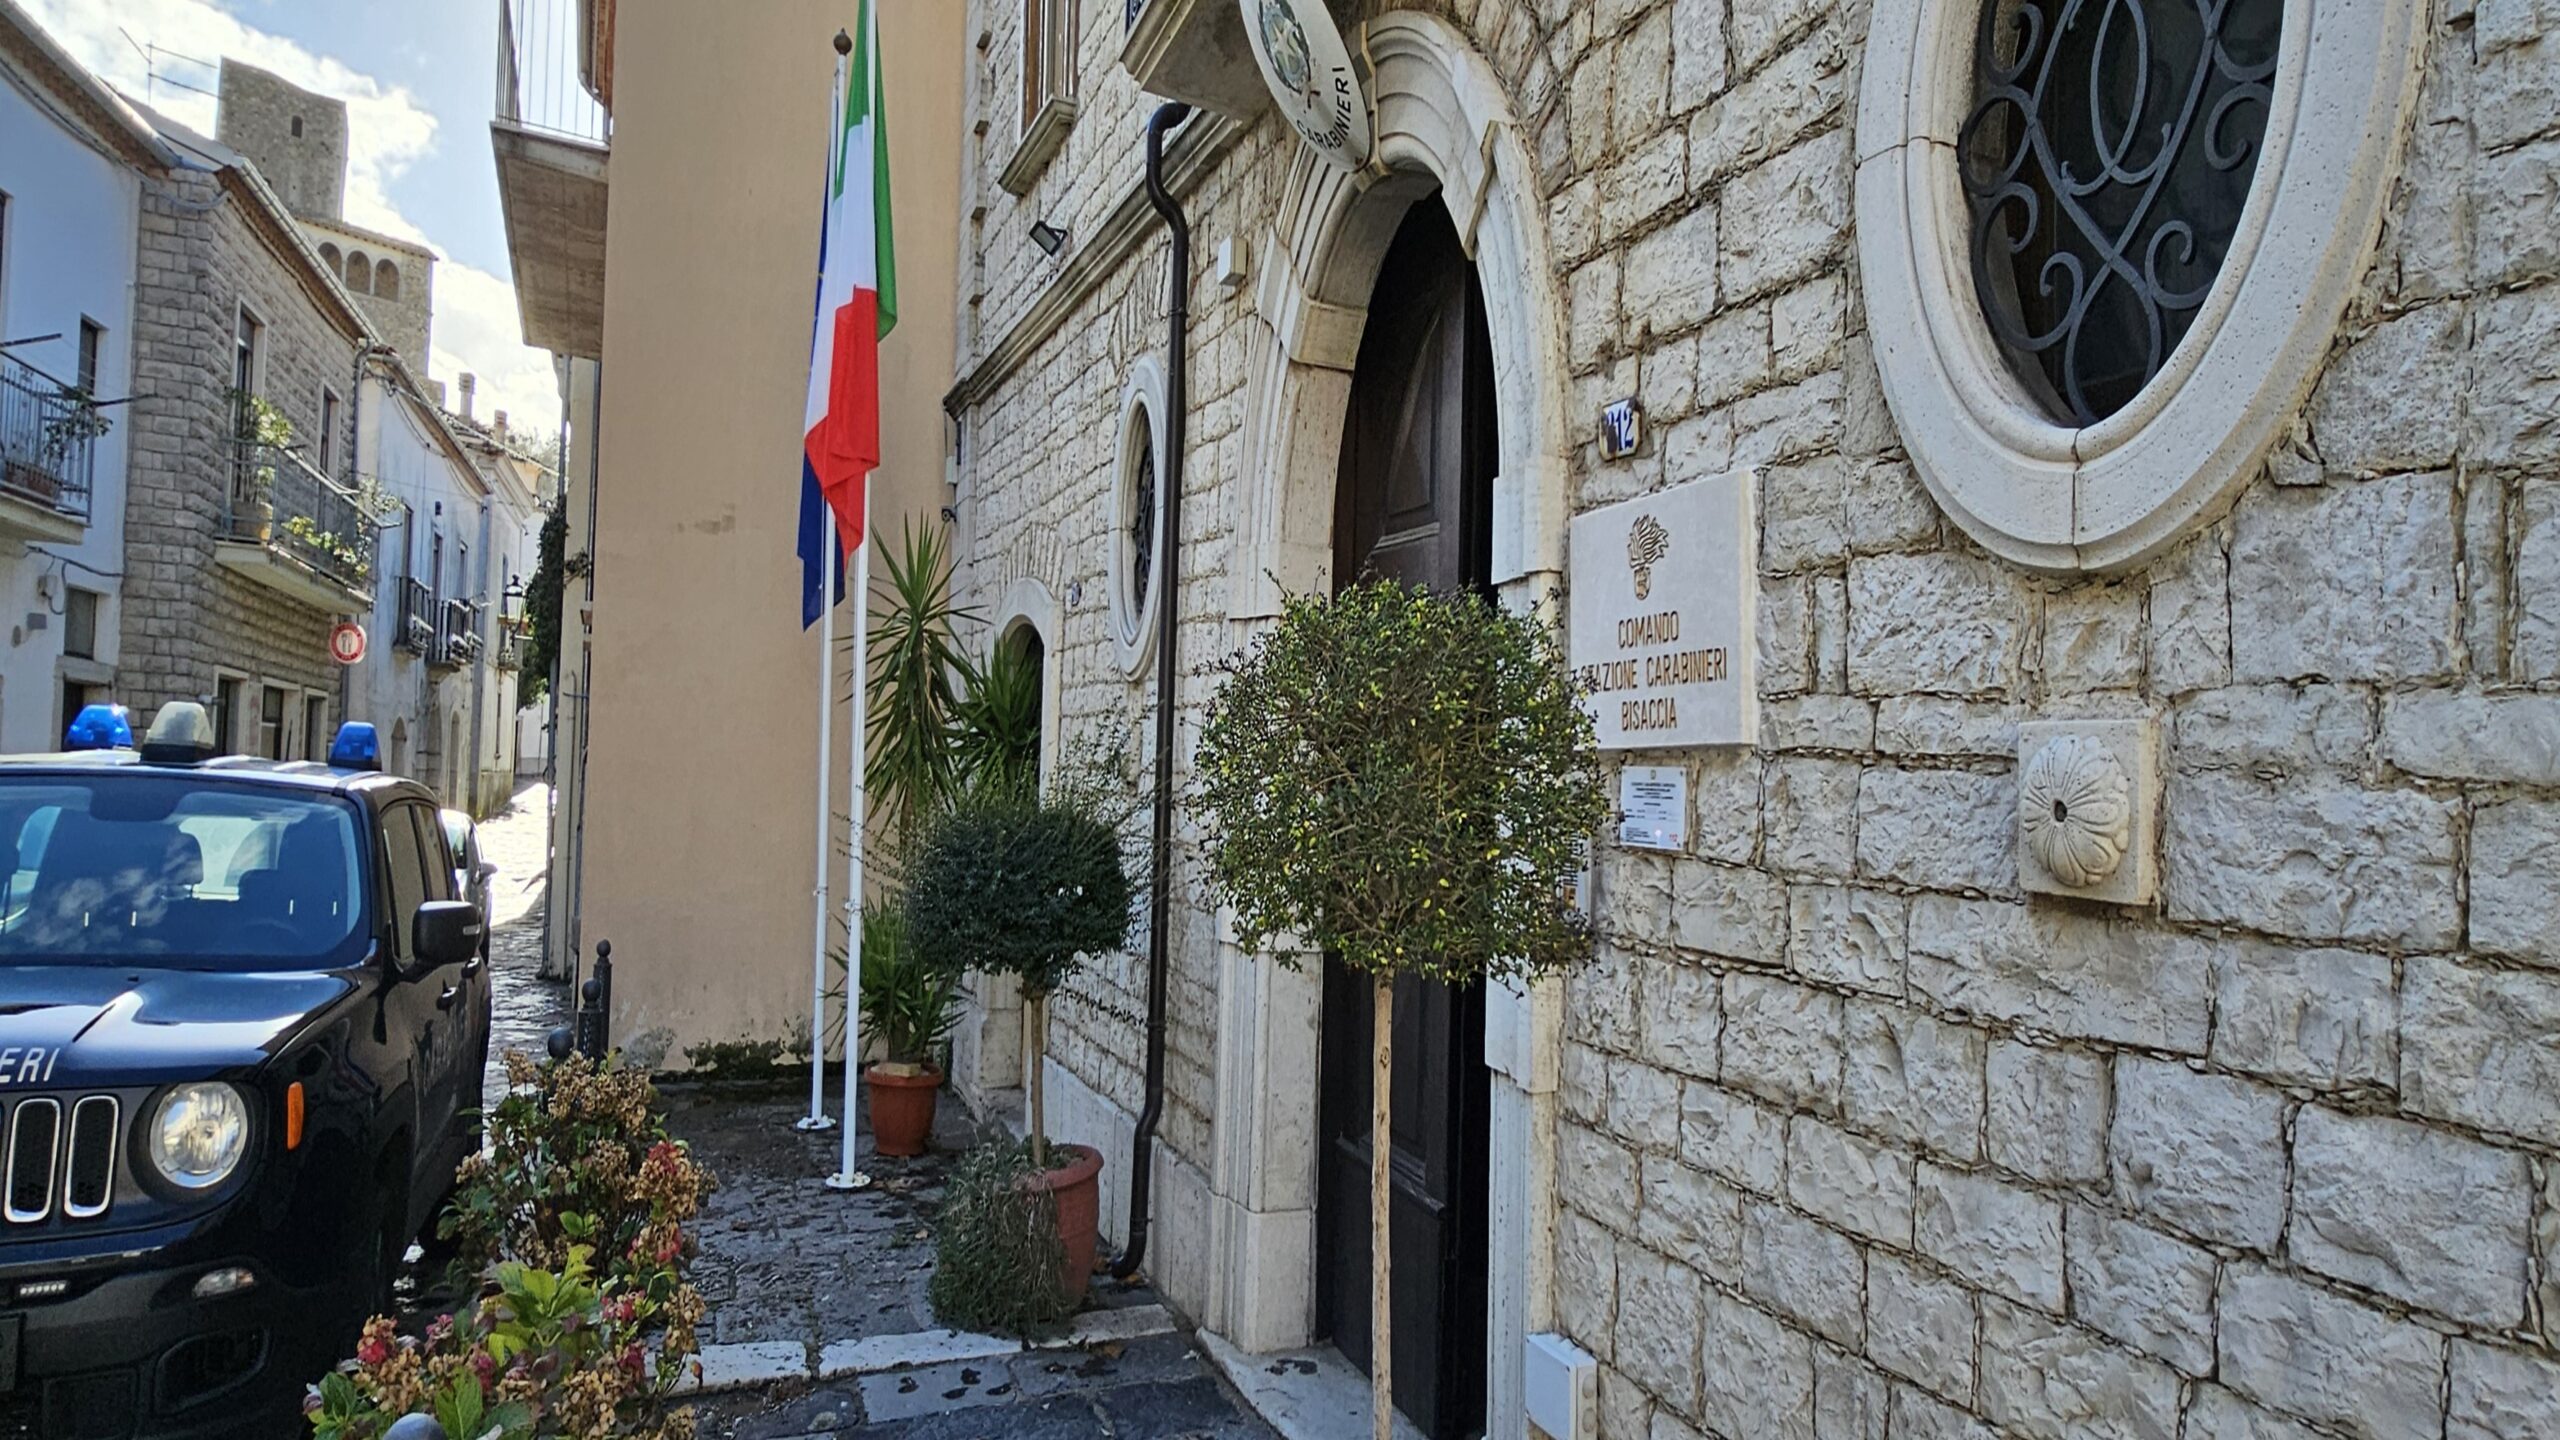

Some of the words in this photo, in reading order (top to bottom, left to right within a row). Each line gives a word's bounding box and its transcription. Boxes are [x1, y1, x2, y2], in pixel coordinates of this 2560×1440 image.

[1296, 66, 1352, 150] CARABINIERI
[1618, 610, 1680, 649] COMANDO
[1646, 647, 1728, 688] CARABINIERI
[1621, 696, 1678, 732] BISACCIA
